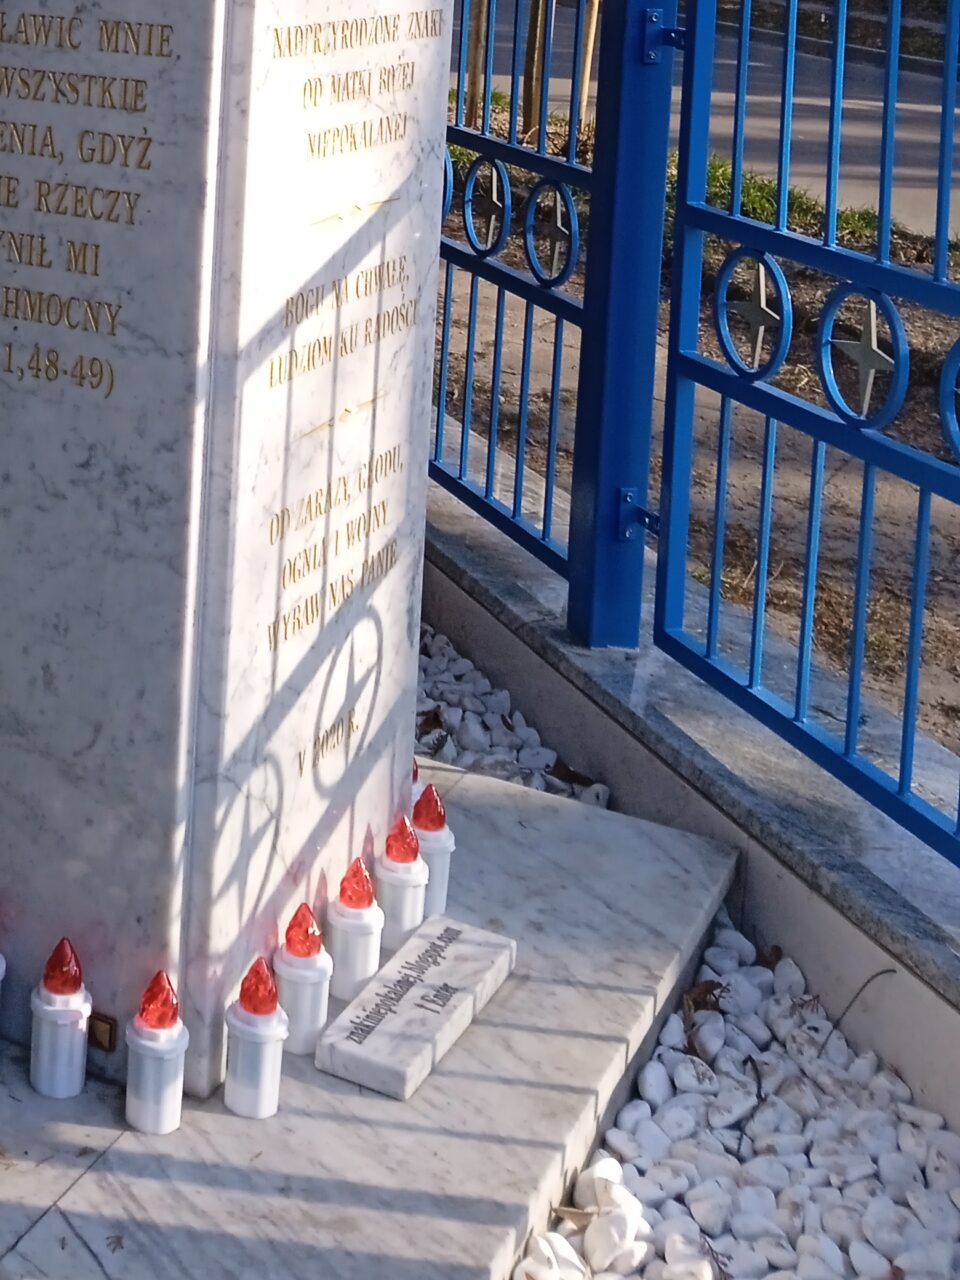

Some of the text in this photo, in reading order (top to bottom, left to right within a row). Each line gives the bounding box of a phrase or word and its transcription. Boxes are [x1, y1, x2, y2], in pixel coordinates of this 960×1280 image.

[273, 14, 400, 59] NADPRZYRODZONE
[303, 54, 416, 109] OD MATKI BOŻEJ
[78, 127, 152, 171] GDYŻ
[307, 112, 408, 160] NIEPOKALANEJ
[34, 179, 141, 226] RZECZY
[66, 239, 101, 277] MI
[283, 284, 325, 329] BOGU
[332, 275, 348, 310] NA
[269, 335, 333, 389] LUDZIOM
[341, 323, 359, 357] KU
[270, 507, 290, 546] OD
[282, 537, 327, 590] OGNIA
[346, 499, 388, 550] WOJNY
[328, 568, 355, 612] NAS
